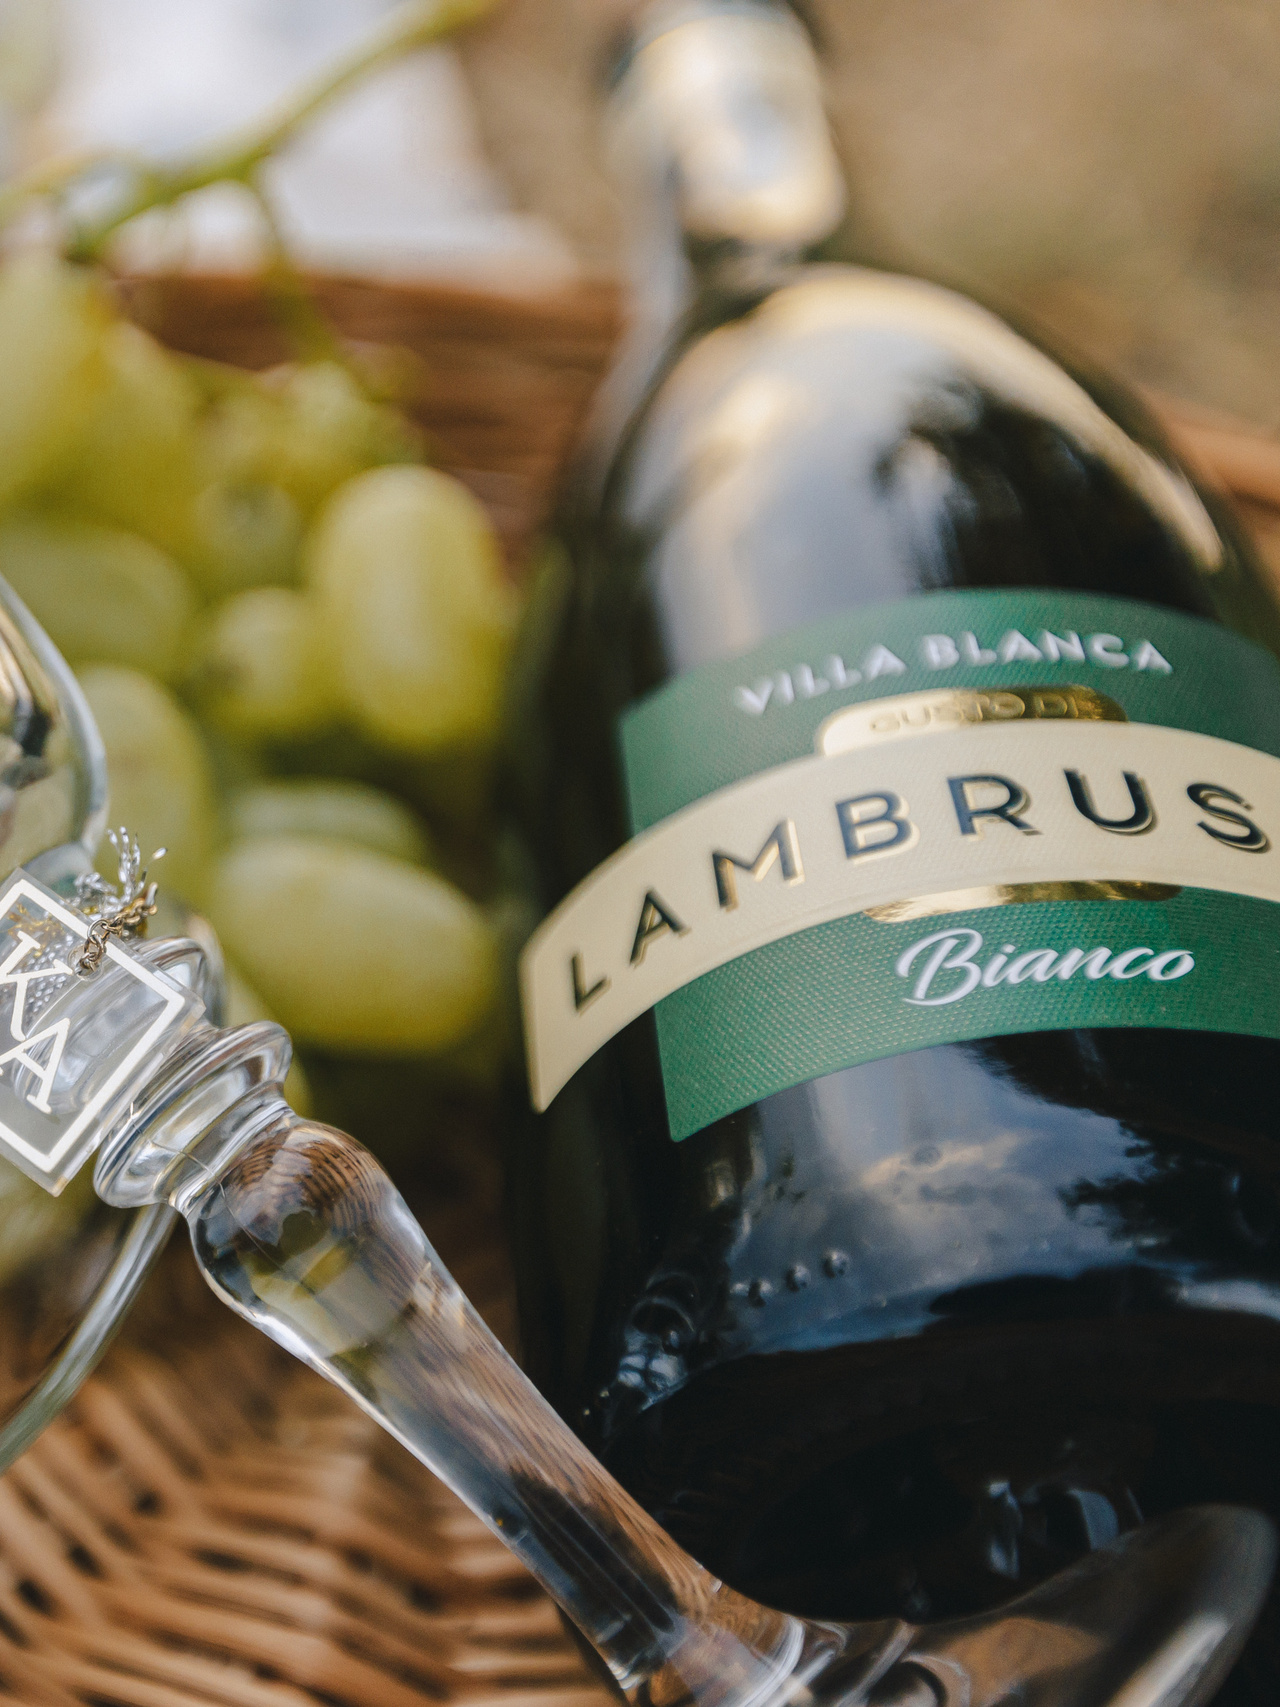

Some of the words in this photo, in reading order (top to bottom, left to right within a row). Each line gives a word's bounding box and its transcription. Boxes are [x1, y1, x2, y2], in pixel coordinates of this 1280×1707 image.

[734, 643, 908, 716] VILLA
[923, 629, 1173, 675] BLANCA
[571, 769, 1271, 1016] LAMBRUS
[895, 928, 1195, 1006] Bianco
